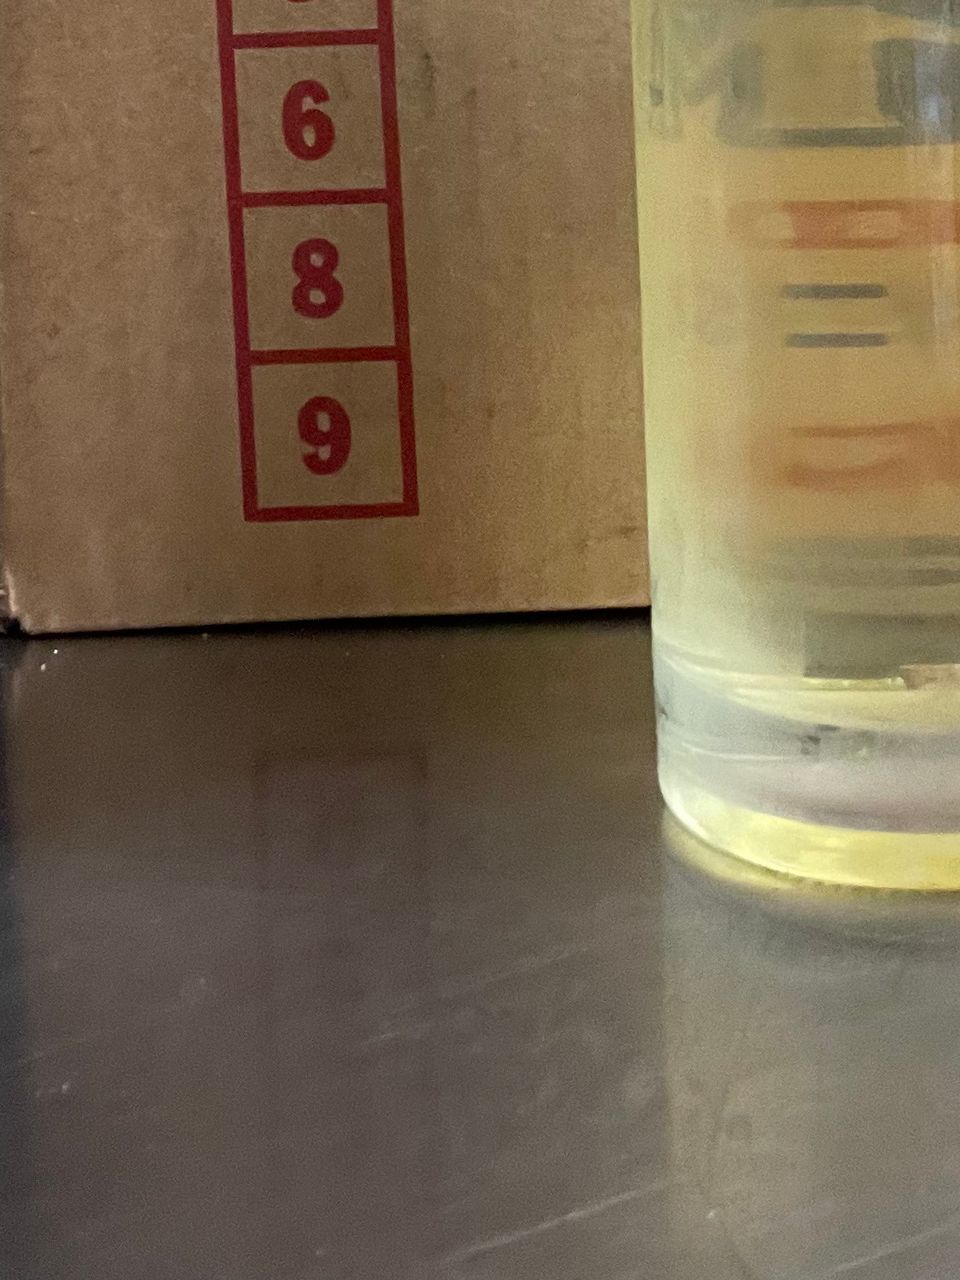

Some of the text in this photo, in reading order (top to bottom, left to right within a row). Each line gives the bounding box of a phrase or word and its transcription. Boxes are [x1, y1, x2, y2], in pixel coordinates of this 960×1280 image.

[281, 79, 336, 161] 6
[291, 238, 344, 319] 8
[297, 396, 351, 475] 9
